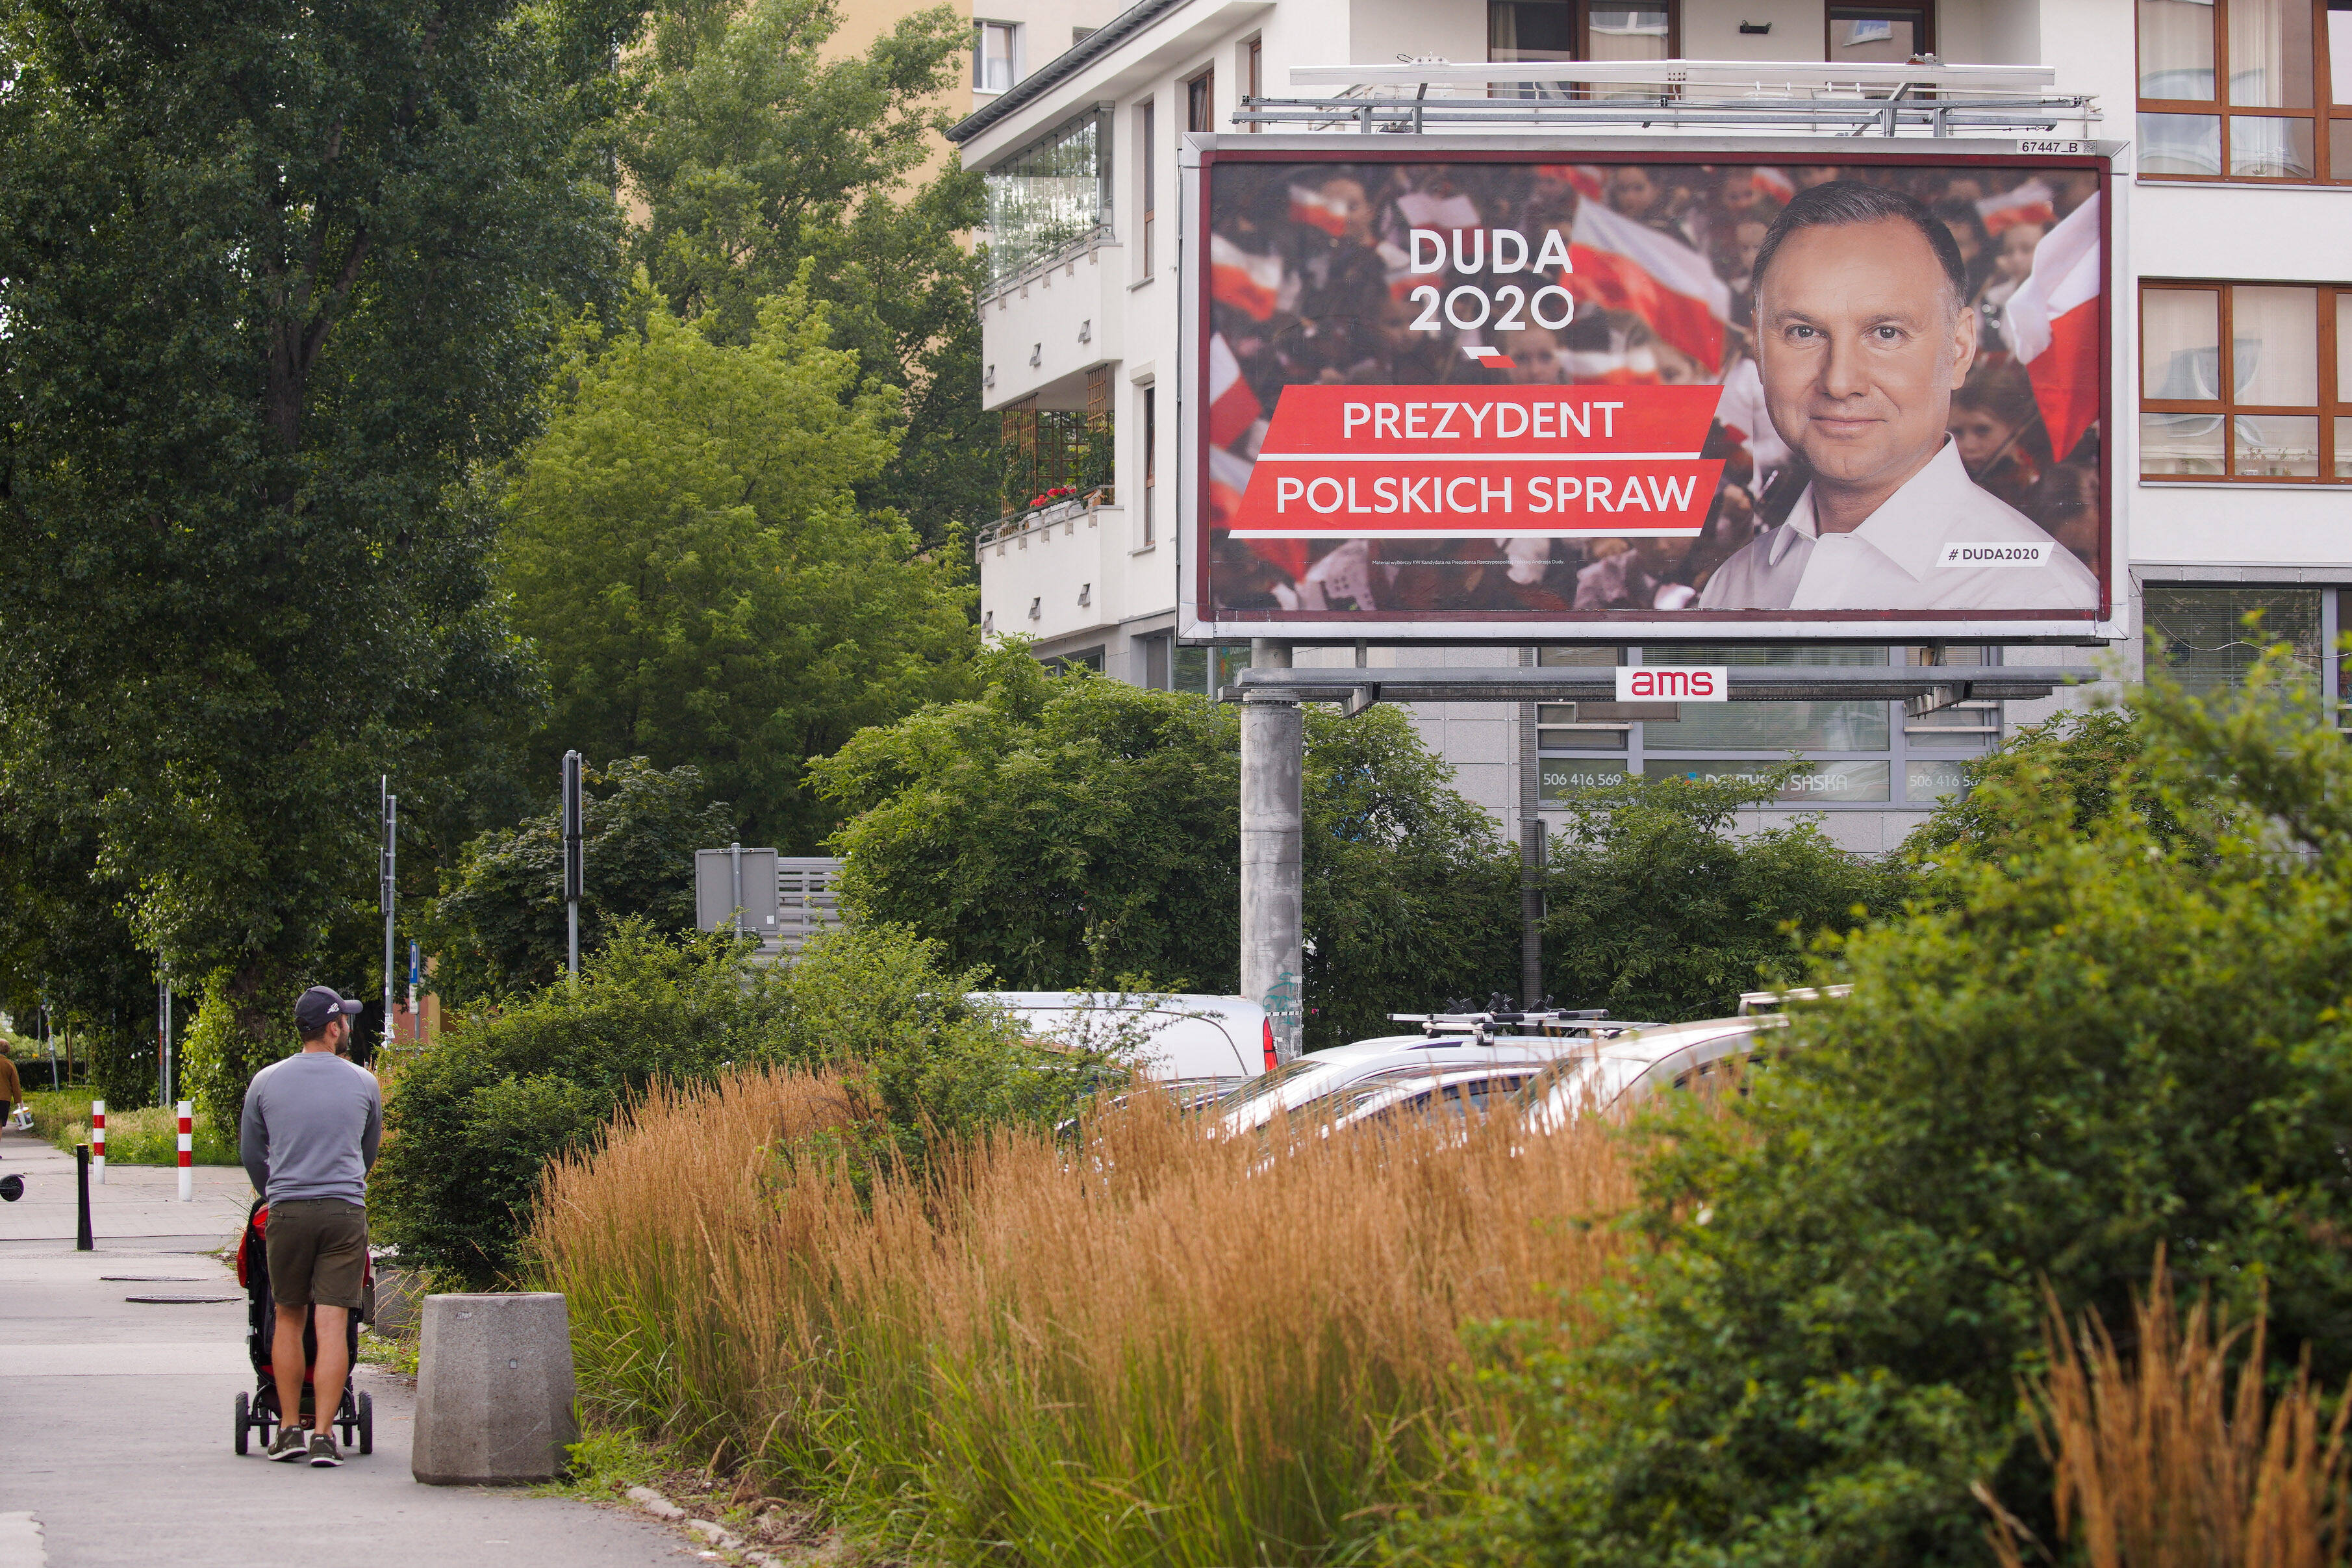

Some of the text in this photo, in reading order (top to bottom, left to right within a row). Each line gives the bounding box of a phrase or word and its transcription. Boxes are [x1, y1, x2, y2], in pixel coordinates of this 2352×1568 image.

[2021, 142, 2078, 153] 67447_B
[1410, 229, 1573, 274] DUDA
[1409, 285, 1574, 331] 2020
[1343, 401, 1624, 438] PREZYDENT
[1276, 475, 1697, 514] POLSKICH SPRAW
[1962, 548, 2039, 560] DUDA2020
[1631, 672, 1713, 696] ams
[1543, 773, 1622, 786] 506 416 569
[1790, 774, 1848, 791] SASKA
[1910, 775, 1932, 787] 506
[1936, 775, 1959, 787] 416
